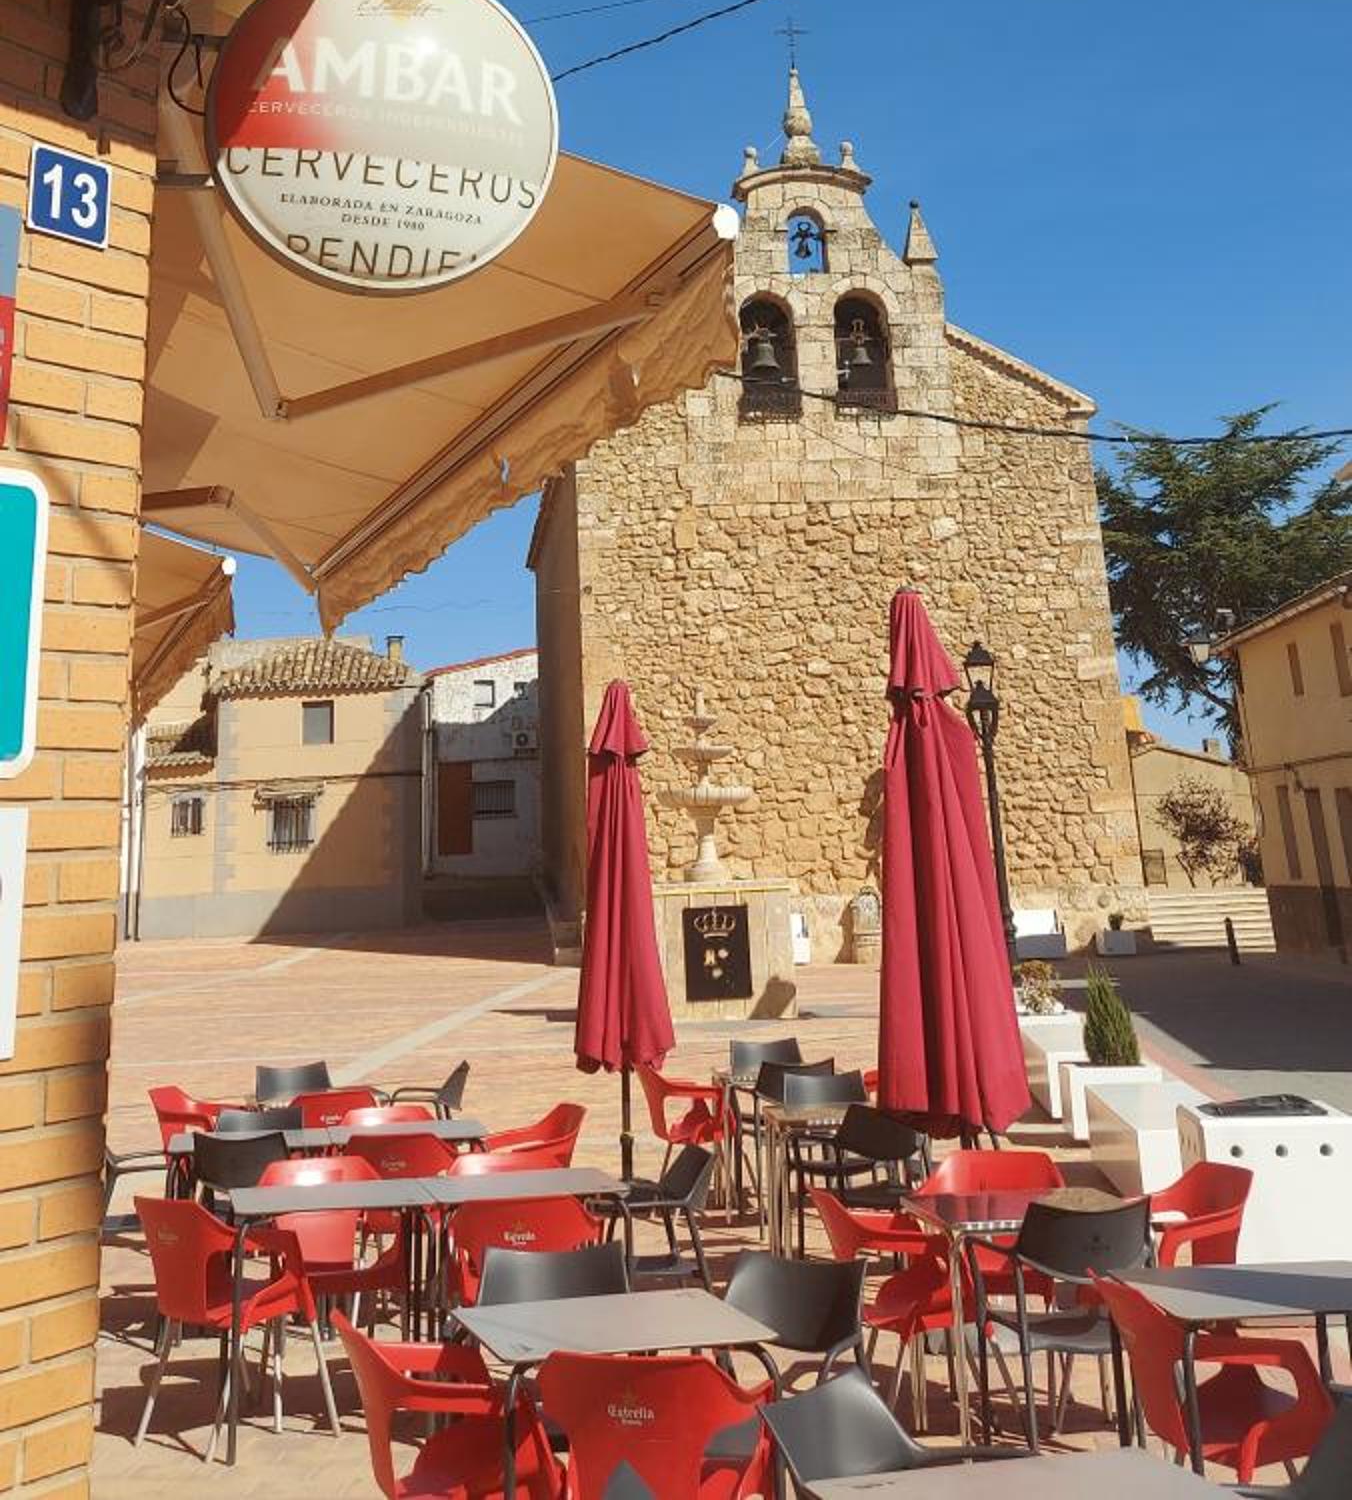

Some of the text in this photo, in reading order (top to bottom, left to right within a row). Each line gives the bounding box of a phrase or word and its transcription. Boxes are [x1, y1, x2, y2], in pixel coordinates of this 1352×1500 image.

[252, 36, 526, 126] AMBAR
[42, 163, 99, 230] 13
[280, 192, 482, 225] ELABORADA EN ZARAGOZA
[341, 213, 426, 232] DESDE 1980
